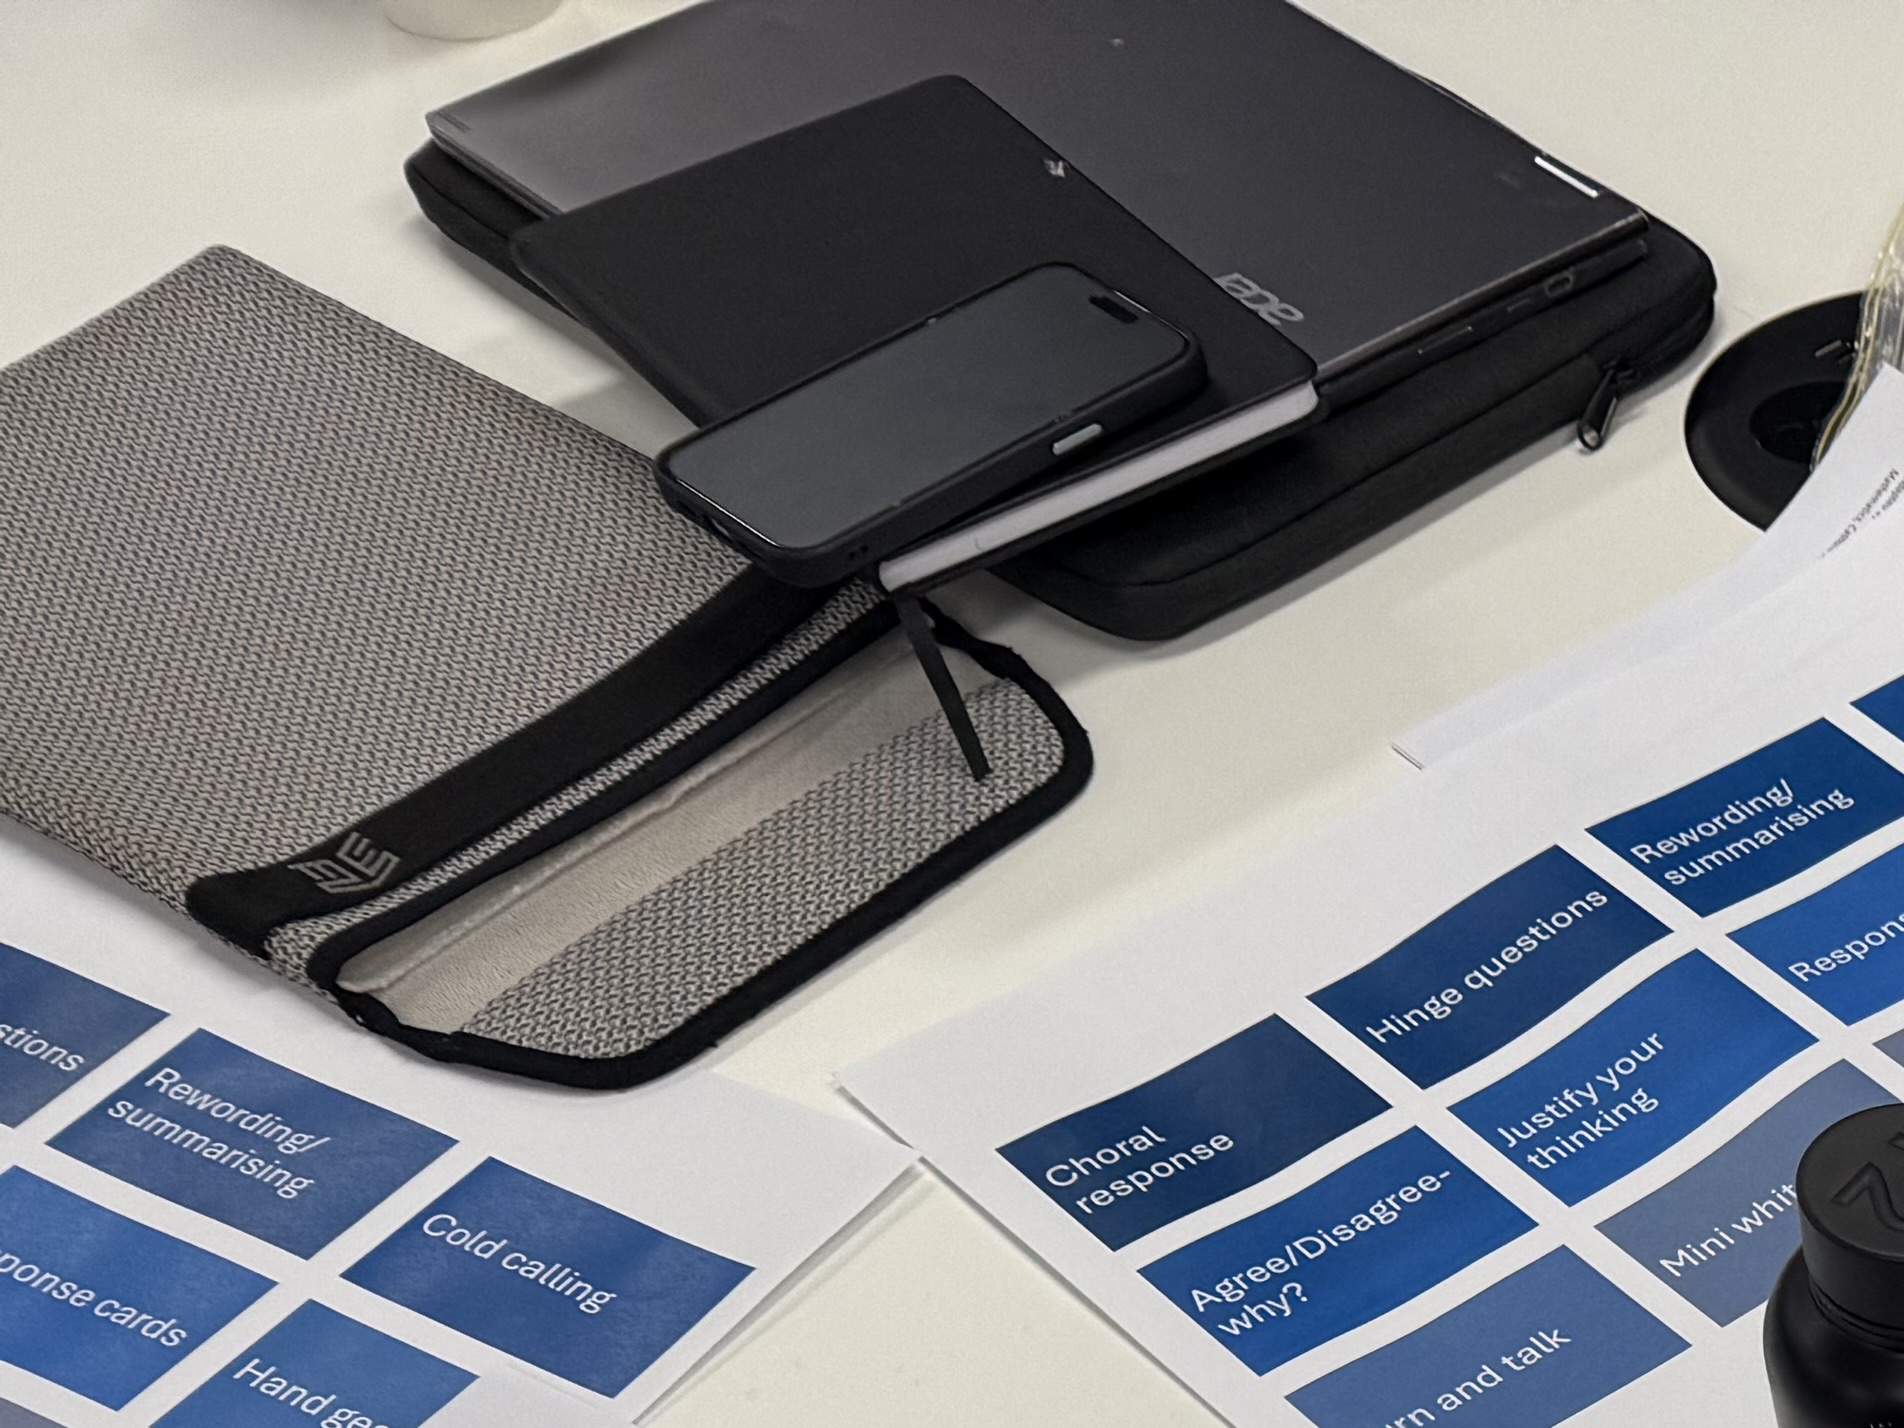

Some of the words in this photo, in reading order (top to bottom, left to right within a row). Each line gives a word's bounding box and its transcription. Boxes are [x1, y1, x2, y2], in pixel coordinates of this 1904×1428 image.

[1630, 779, 1796, 866] Rewording/
[1662, 787, 1855, 889] summarising
[1365, 984, 1464, 1048] Hinge
[1462, 888, 1608, 994] questions
[145, 1066, 332, 1156] Rewording/
[1496, 1068, 1603, 1150] Justify
[1594, 1030, 1666, 1102] your
[1525, 1086, 1659, 1175] thinking
[106, 1097, 314, 1200] summarising
[1045, 1127, 1166, 1191] Choral
[1073, 1129, 1236, 1216] response
[422, 1211, 506, 1262] Cold
[498, 1247, 617, 1315] calling
[1189, 1166, 1453, 1314] Agree/Disagree-
[1660, 1228, 1727, 1280] Mini
[1719, 1183, 1798, 1244] whit
[93, 1299, 188, 1348] cards
[1216, 1281, 1310, 1341] why?
[234, 1356, 332, 1416] Hand
[1435, 1362, 1505, 1412] and
[1500, 1323, 1572, 1378] talk
